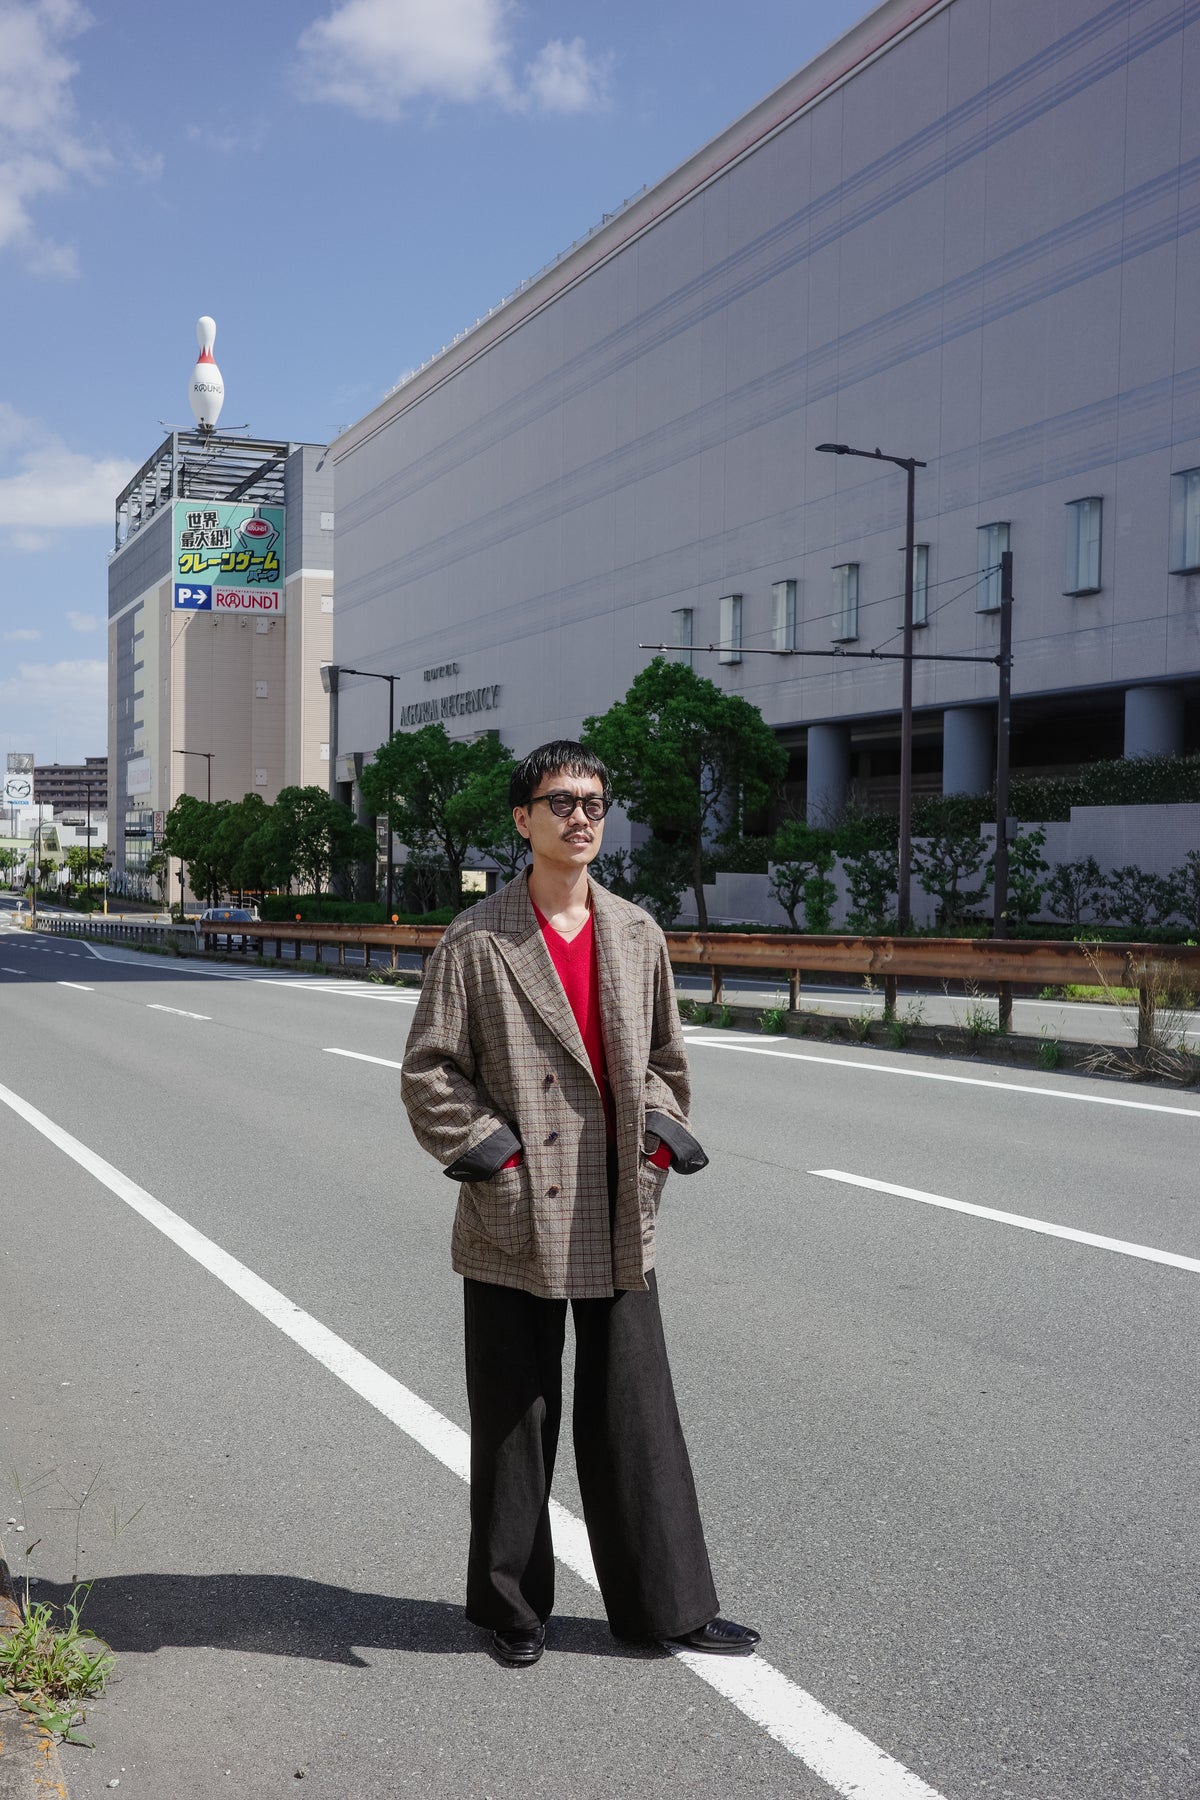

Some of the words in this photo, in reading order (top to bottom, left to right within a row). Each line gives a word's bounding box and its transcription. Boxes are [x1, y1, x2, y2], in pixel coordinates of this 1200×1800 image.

[187, 512, 219, 530] 世界
[181, 529, 231, 549] 最大級!
[179, 551, 279, 574] クレーンゲーム
[248, 569, 279, 583] パーク
[178, 588, 192, 604] P
[216, 592, 278, 610] ROUND1
[440, 684, 500, 718] REGENCY
